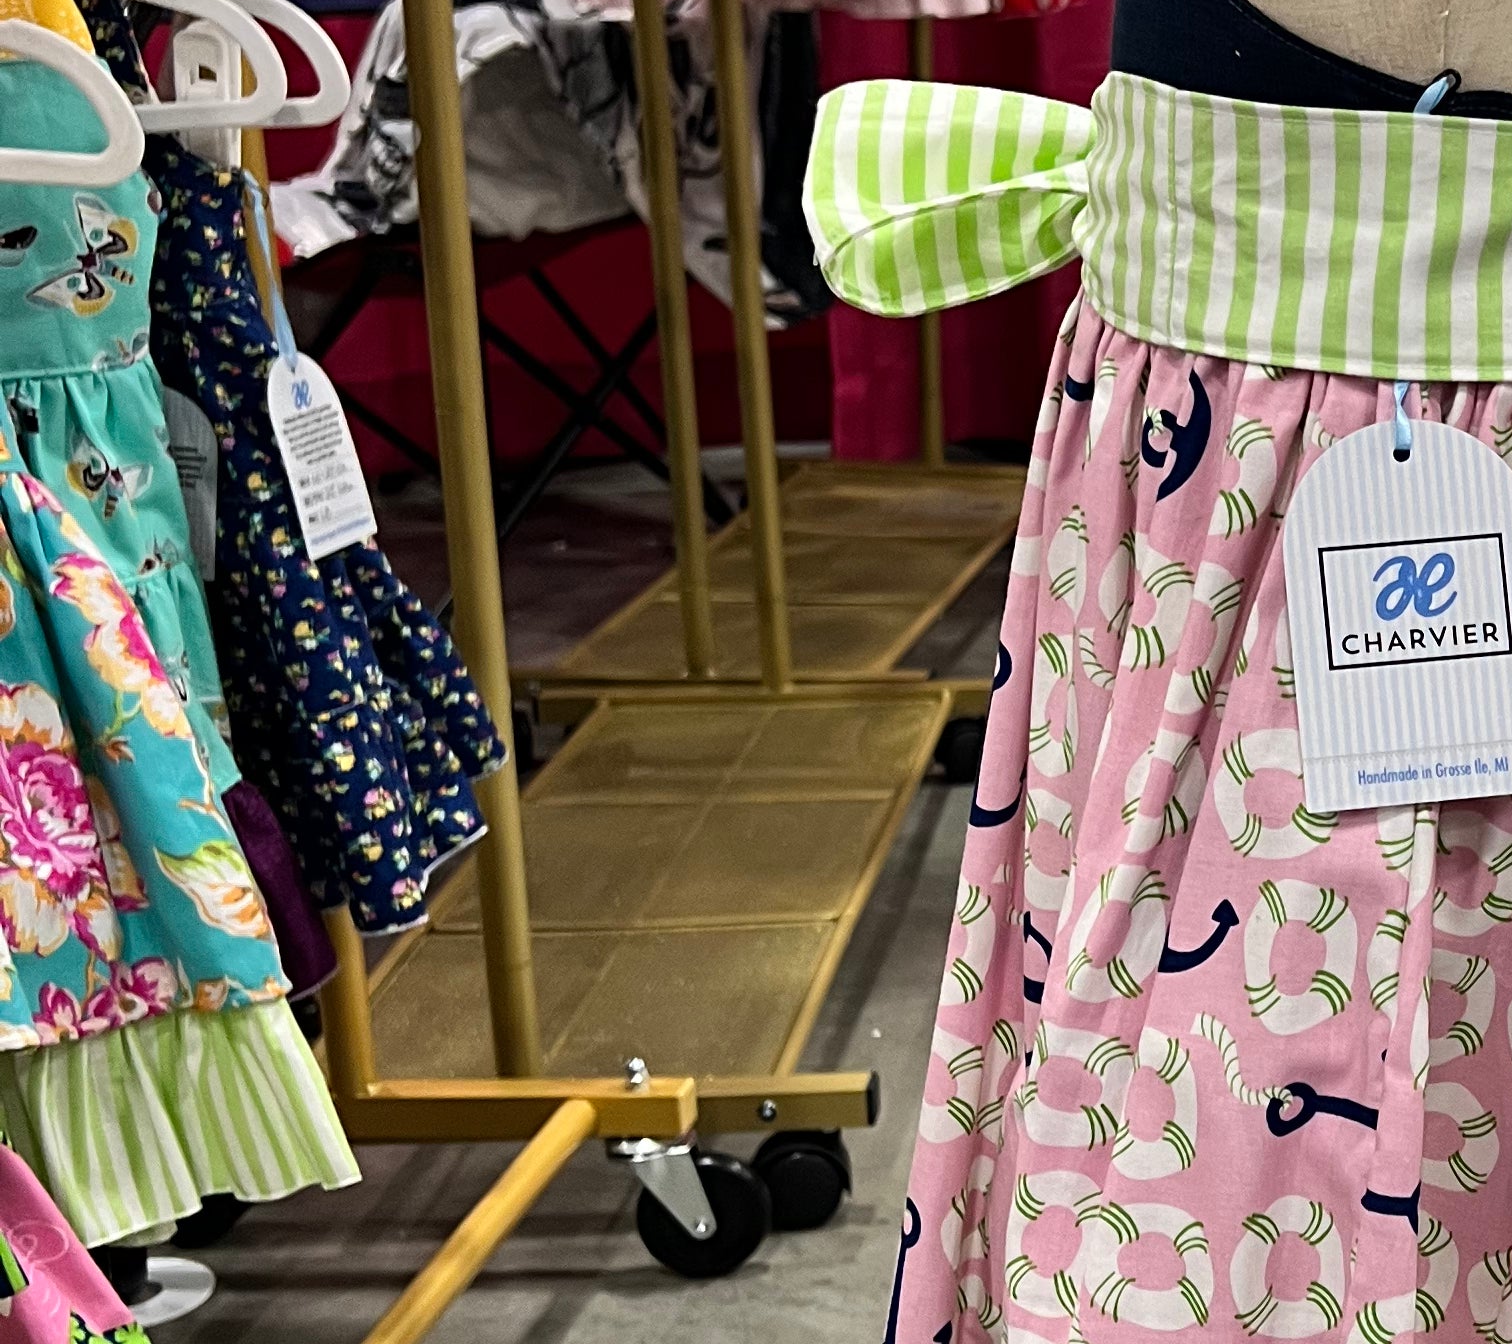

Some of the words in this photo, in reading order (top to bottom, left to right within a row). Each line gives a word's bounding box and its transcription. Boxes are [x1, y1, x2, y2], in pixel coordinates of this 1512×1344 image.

[1341, 622, 1499, 656] CHARVIER
[1357, 763, 1418, 785] Handmade
[1421, 764, 1433, 779] in
[1435, 762, 1472, 778] Grosse
[1494, 756, 1509, 773] MI
